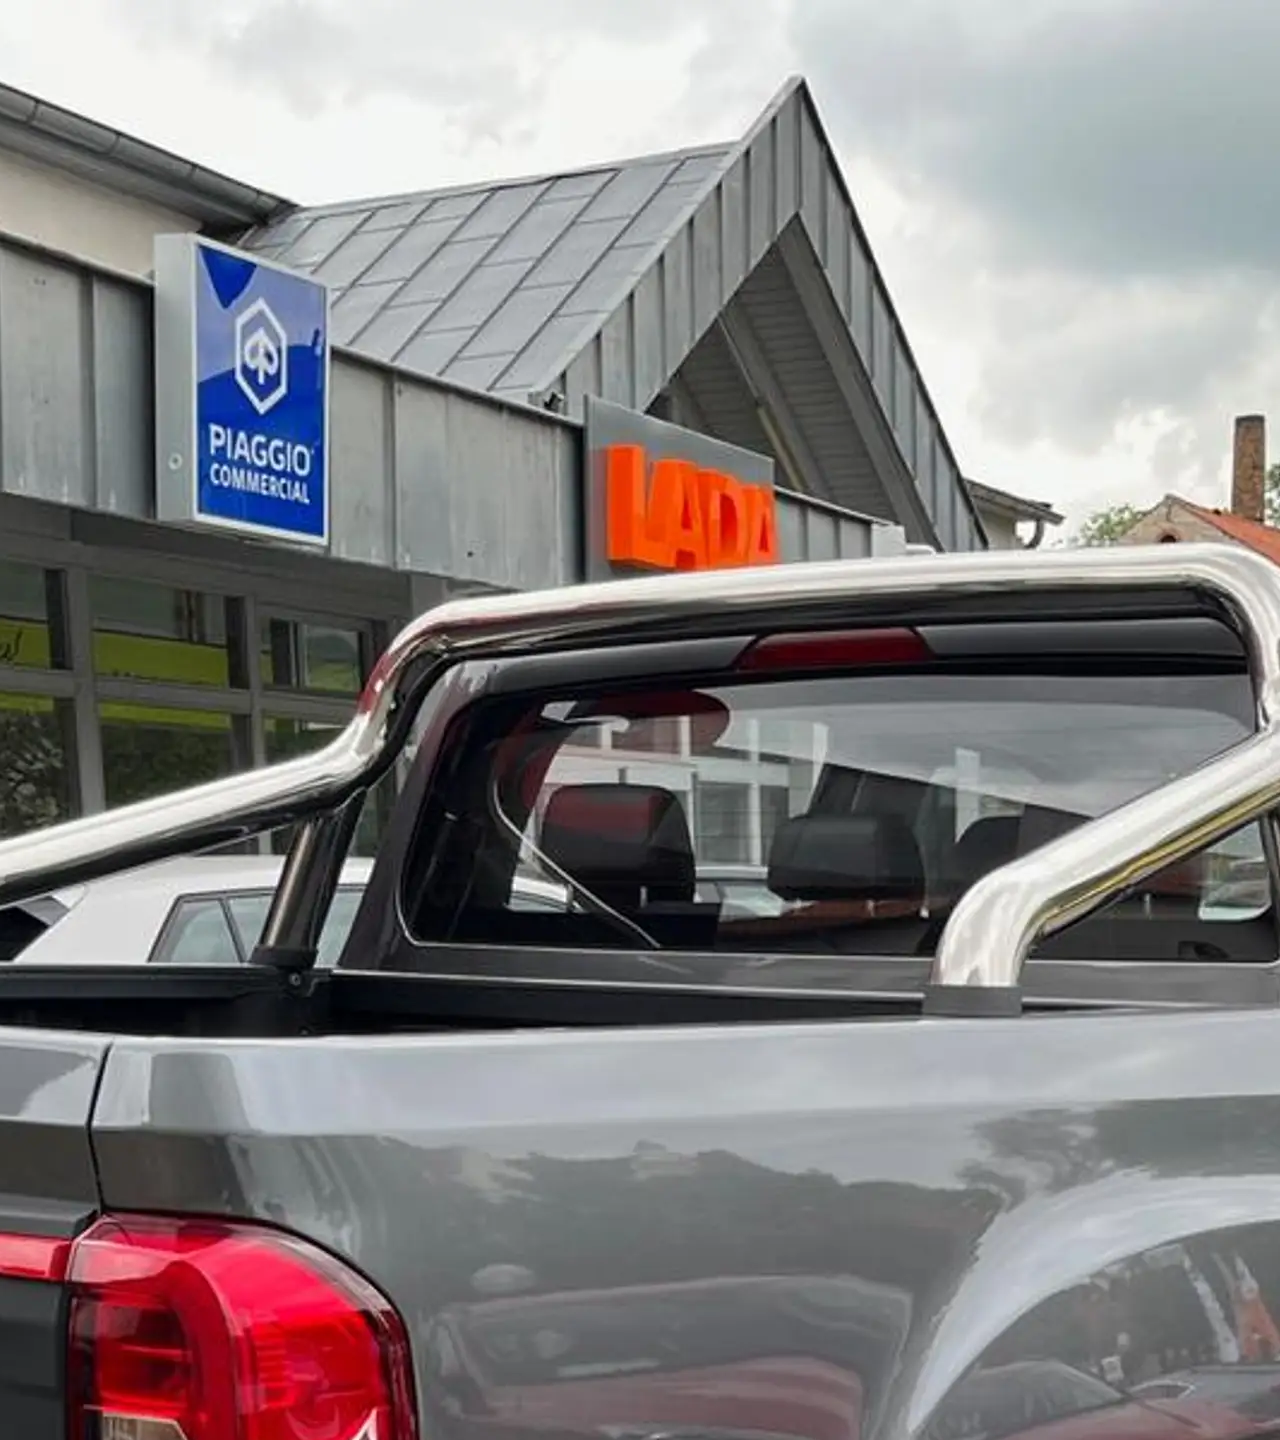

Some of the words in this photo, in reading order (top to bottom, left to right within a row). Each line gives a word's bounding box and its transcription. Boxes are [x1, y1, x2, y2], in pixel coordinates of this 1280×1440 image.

[209, 422, 310, 477] PIAGGIO
[210, 462, 310, 505] COMMERCIAL
[607, 443, 780, 572] LADA
